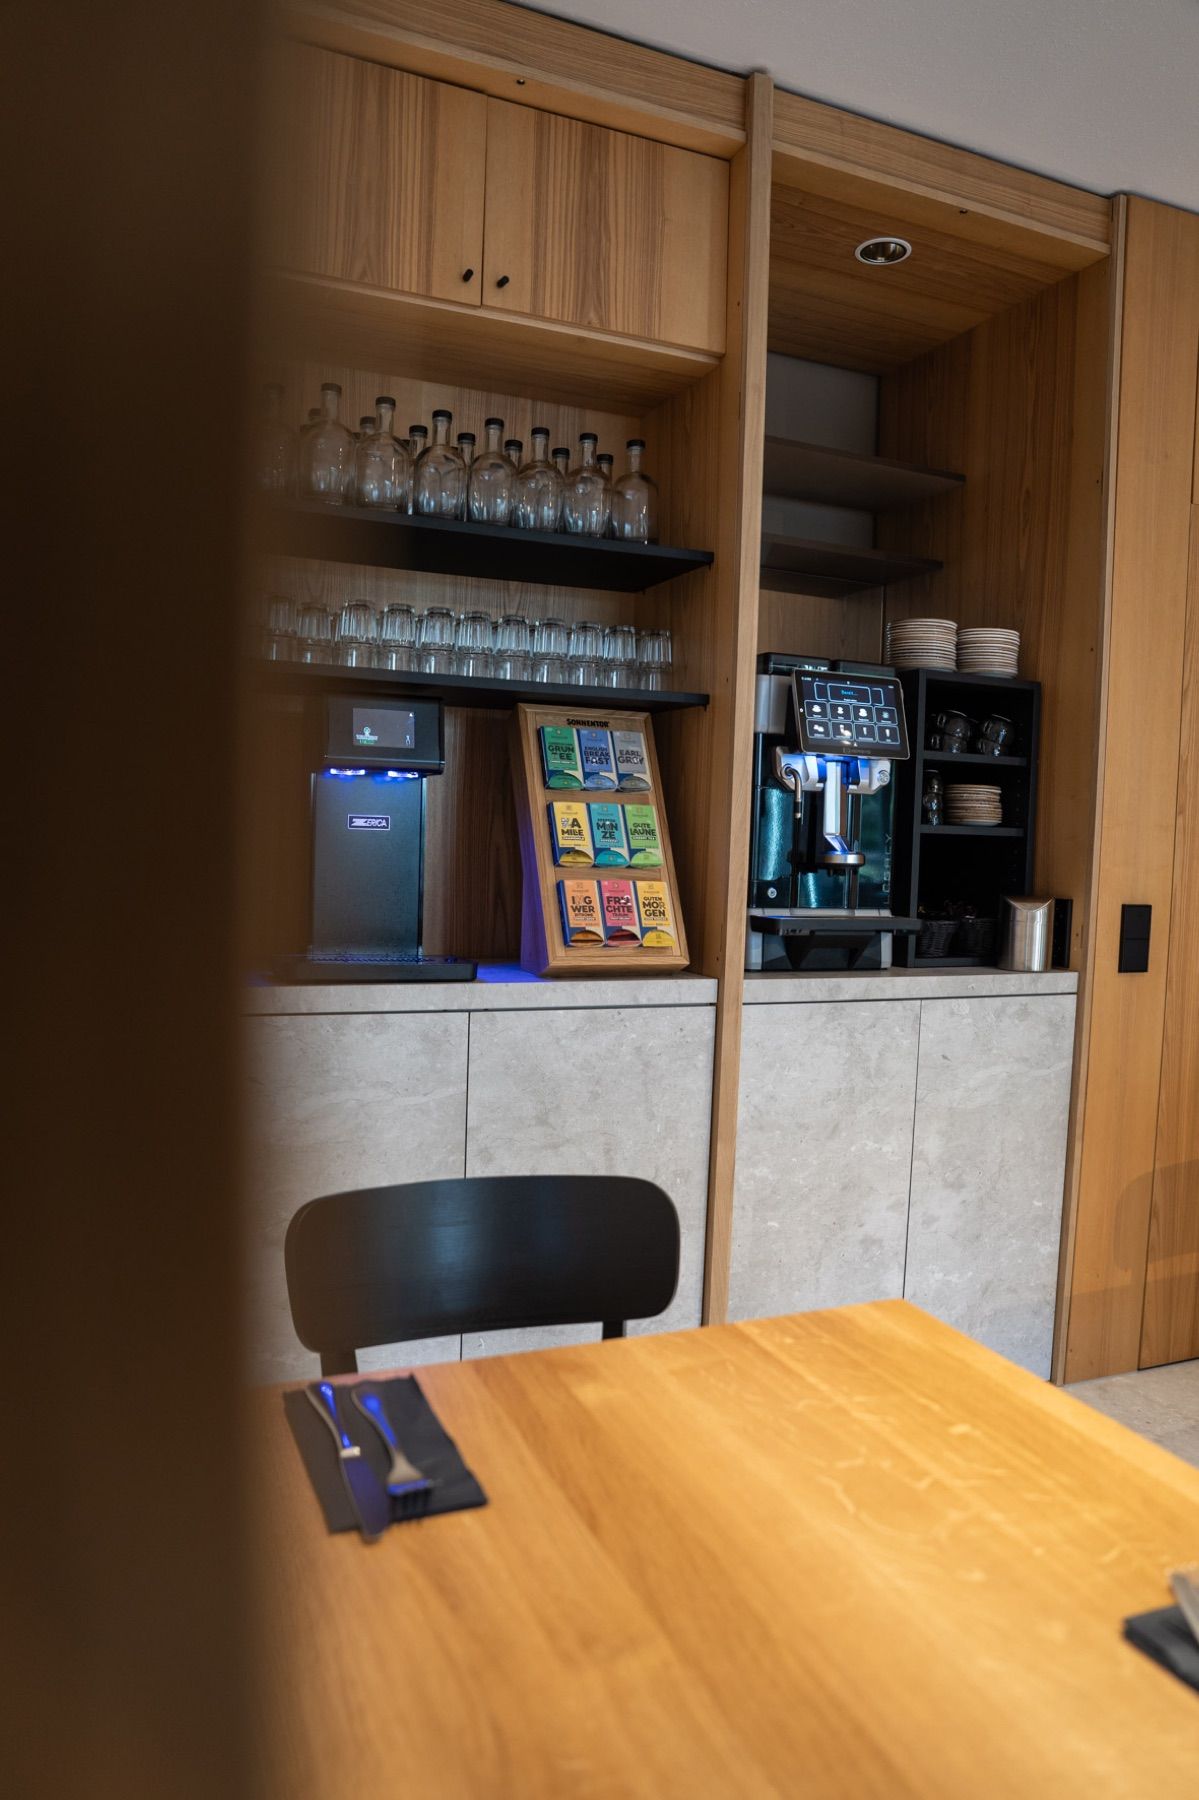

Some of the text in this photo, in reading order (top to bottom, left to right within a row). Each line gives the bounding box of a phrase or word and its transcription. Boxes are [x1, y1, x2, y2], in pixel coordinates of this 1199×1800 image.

[551, 752, 572, 760] TEE
[601, 830, 616, 840] ZE
[630, 828, 656, 836] LAUNE
[571, 895, 592, 905] IG
[571, 905, 595, 913] WER
[606, 905, 633, 913] CHTE
[644, 909, 666, 917] GEN
